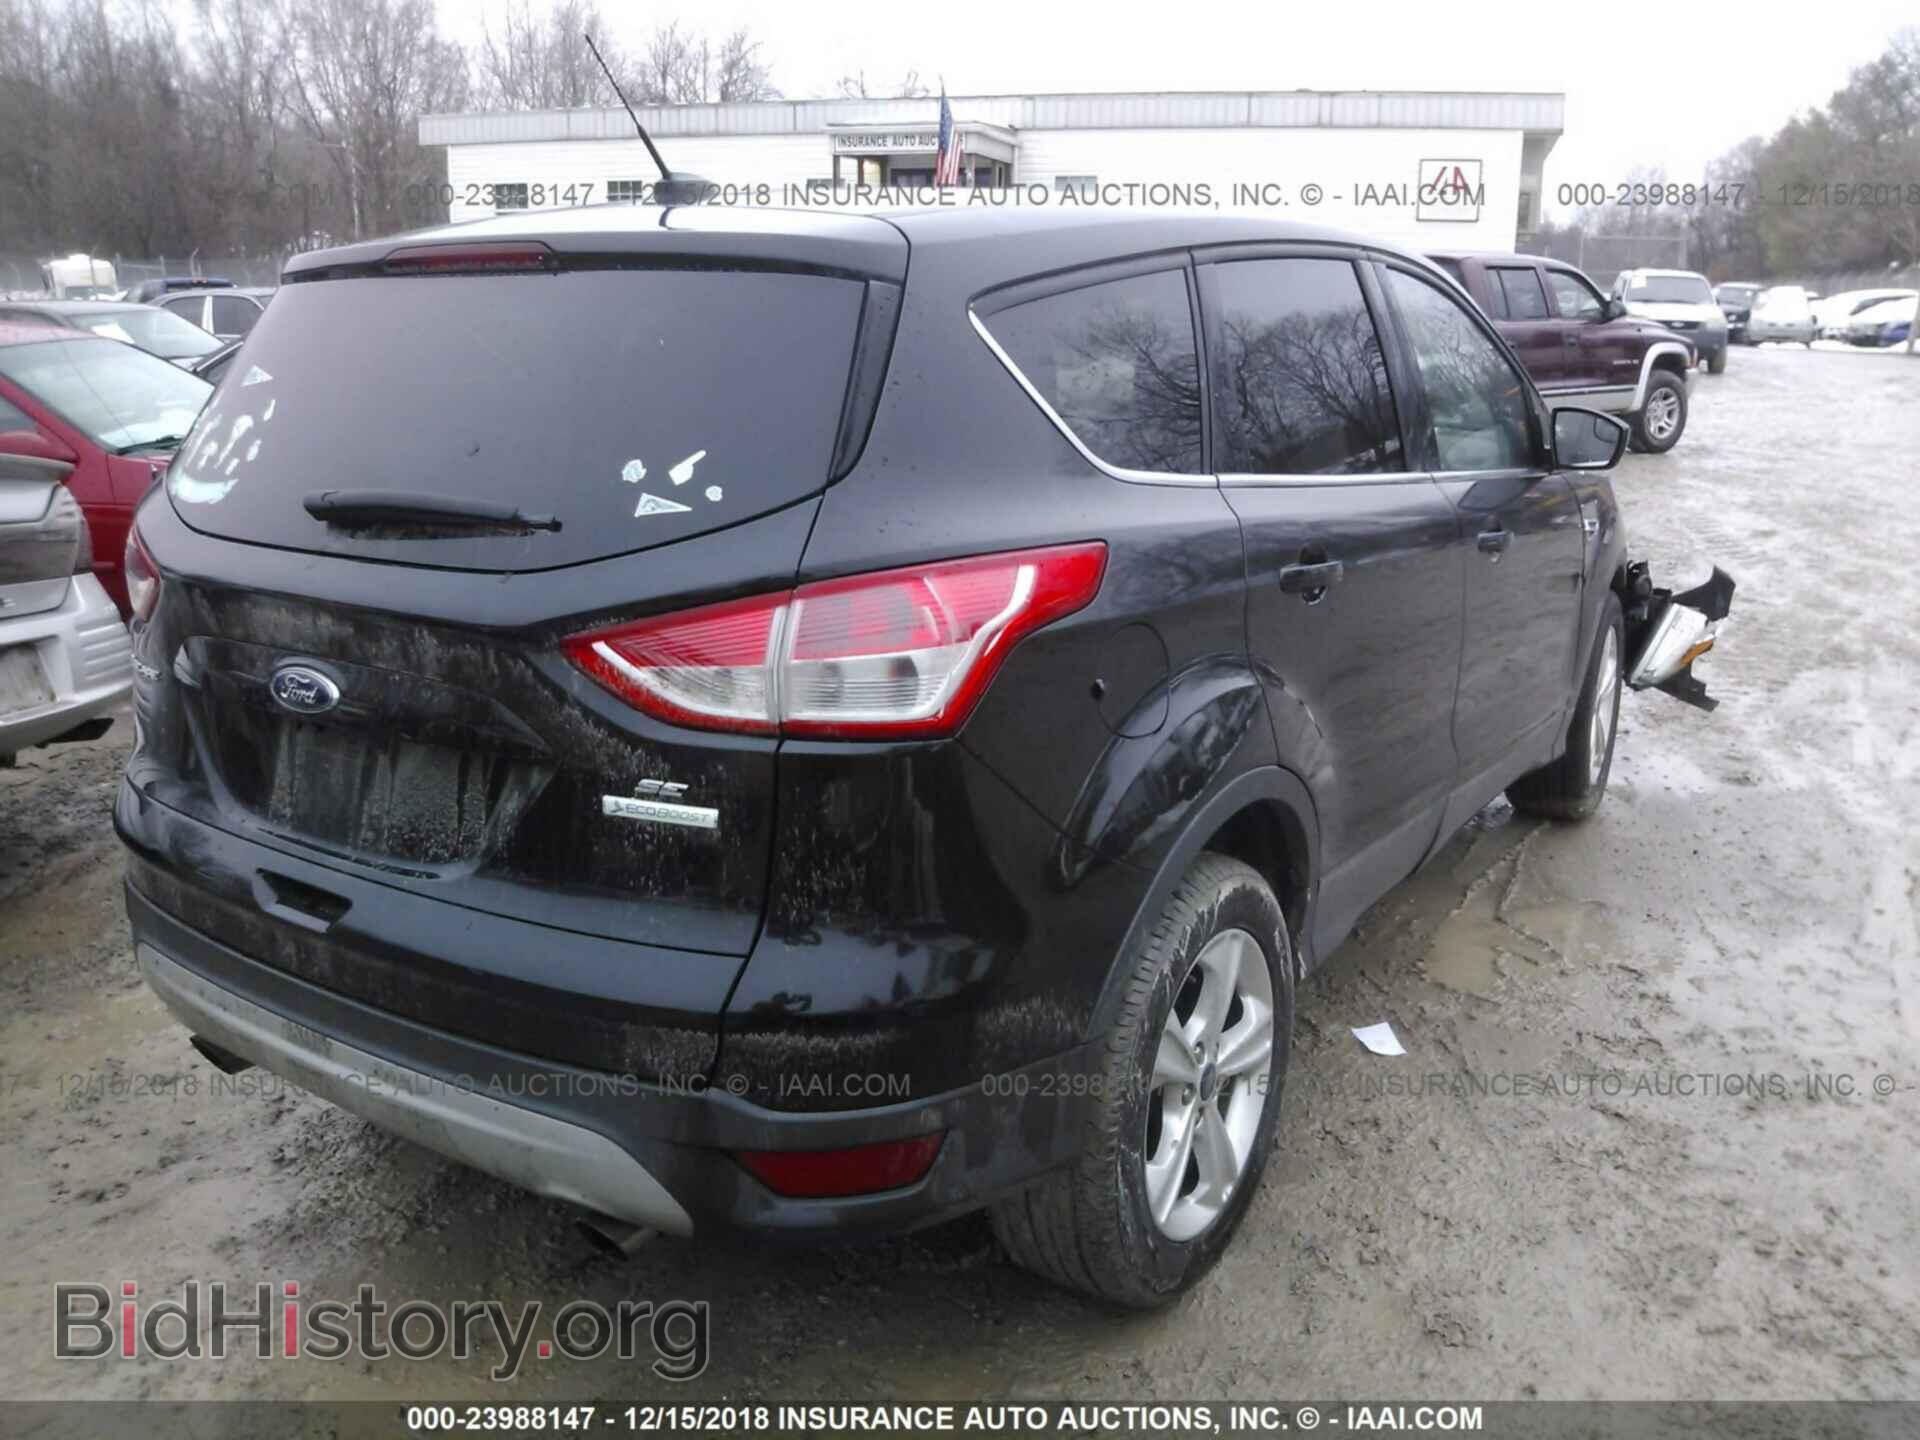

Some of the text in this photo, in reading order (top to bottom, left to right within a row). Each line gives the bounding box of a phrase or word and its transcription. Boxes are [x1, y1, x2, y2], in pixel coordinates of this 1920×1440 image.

[838, 135, 888, 147] INSURANCE
[892, 135, 916, 146] AUTO
[280, 674, 319, 704] Ford
[634, 778, 689, 797] SE
